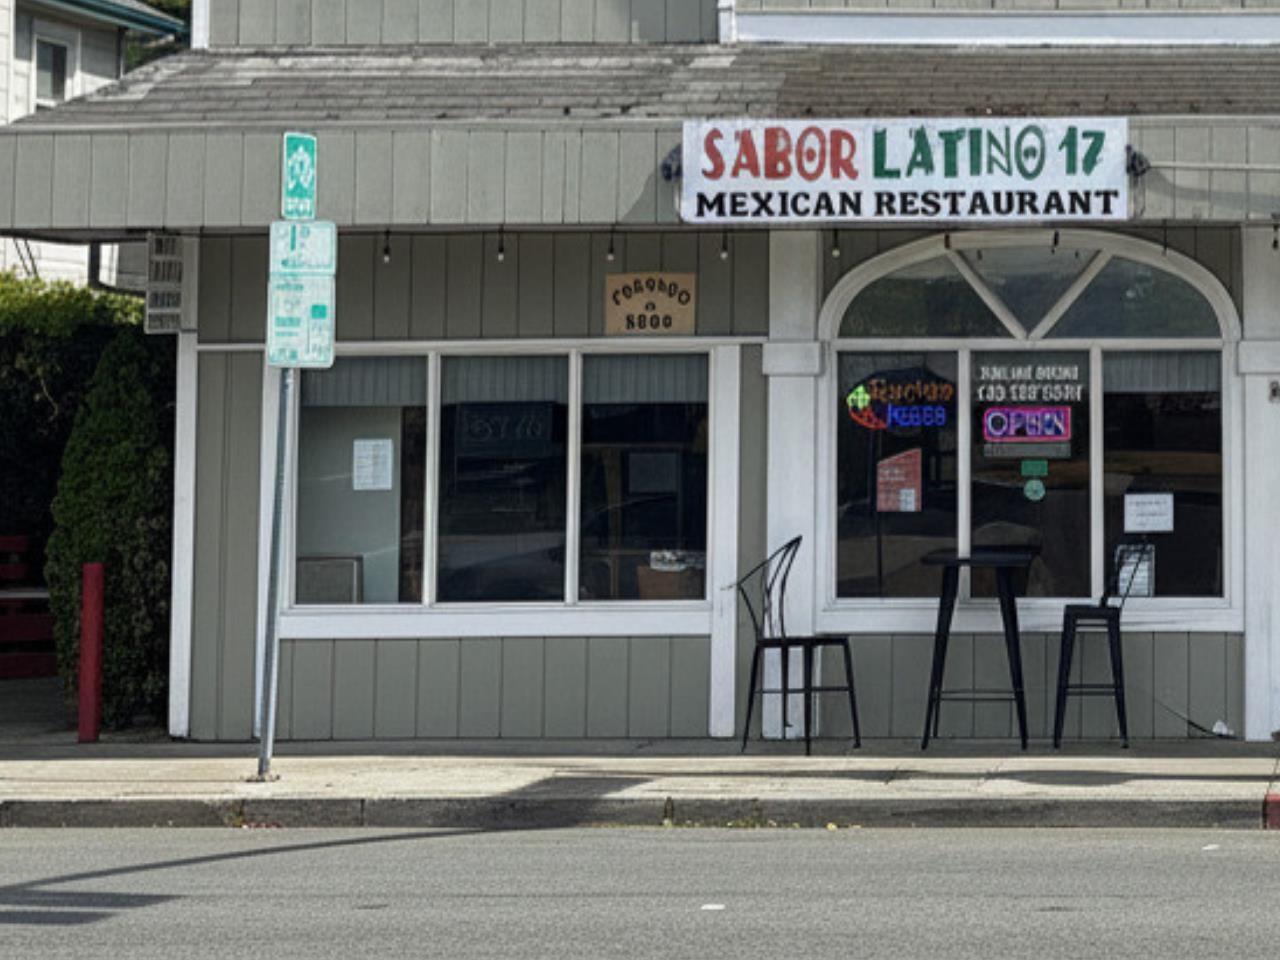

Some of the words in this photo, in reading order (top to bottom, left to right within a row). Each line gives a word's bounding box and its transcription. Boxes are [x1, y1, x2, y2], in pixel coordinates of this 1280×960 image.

[701, 125, 859, 182] SABOR
[873, 124, 1046, 181] LATINO
[1058, 126, 1106, 177] 17
[696, 191, 862, 217] MEXICAN
[873, 189, 1119, 216] RESTAURANT
